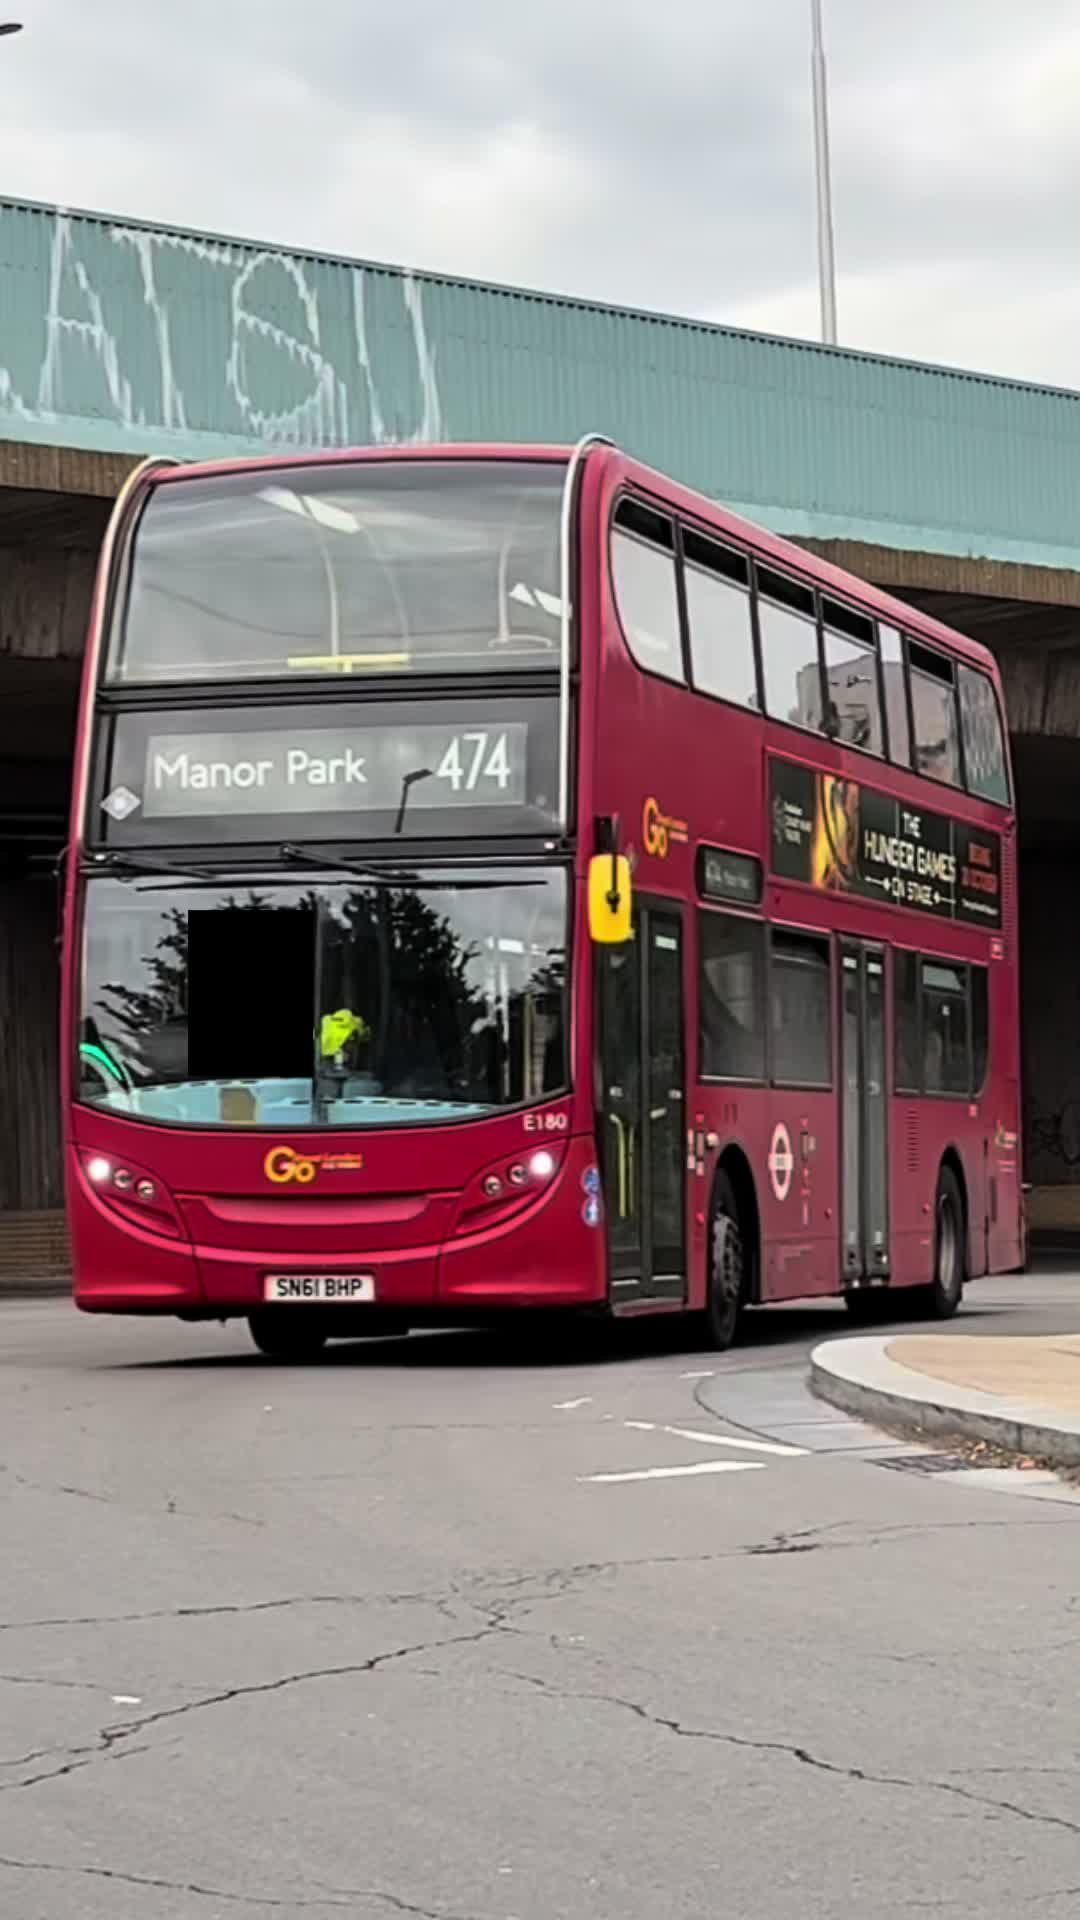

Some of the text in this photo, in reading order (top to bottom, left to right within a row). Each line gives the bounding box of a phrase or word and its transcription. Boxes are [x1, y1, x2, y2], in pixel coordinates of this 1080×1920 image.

[153, 748, 368, 790] Manor Park
[436, 732, 512, 791] 474
[902, 811, 921, 839] THE
[863, 829, 915, 873] HUNGER
[916, 845, 957, 884] GAMES
[891, 876, 906, 897] ON
[523, 1111, 568, 1131] E180
[264, 1145, 316, 1183] Go
[276, 1278, 363, 1297] SN61 BHP
